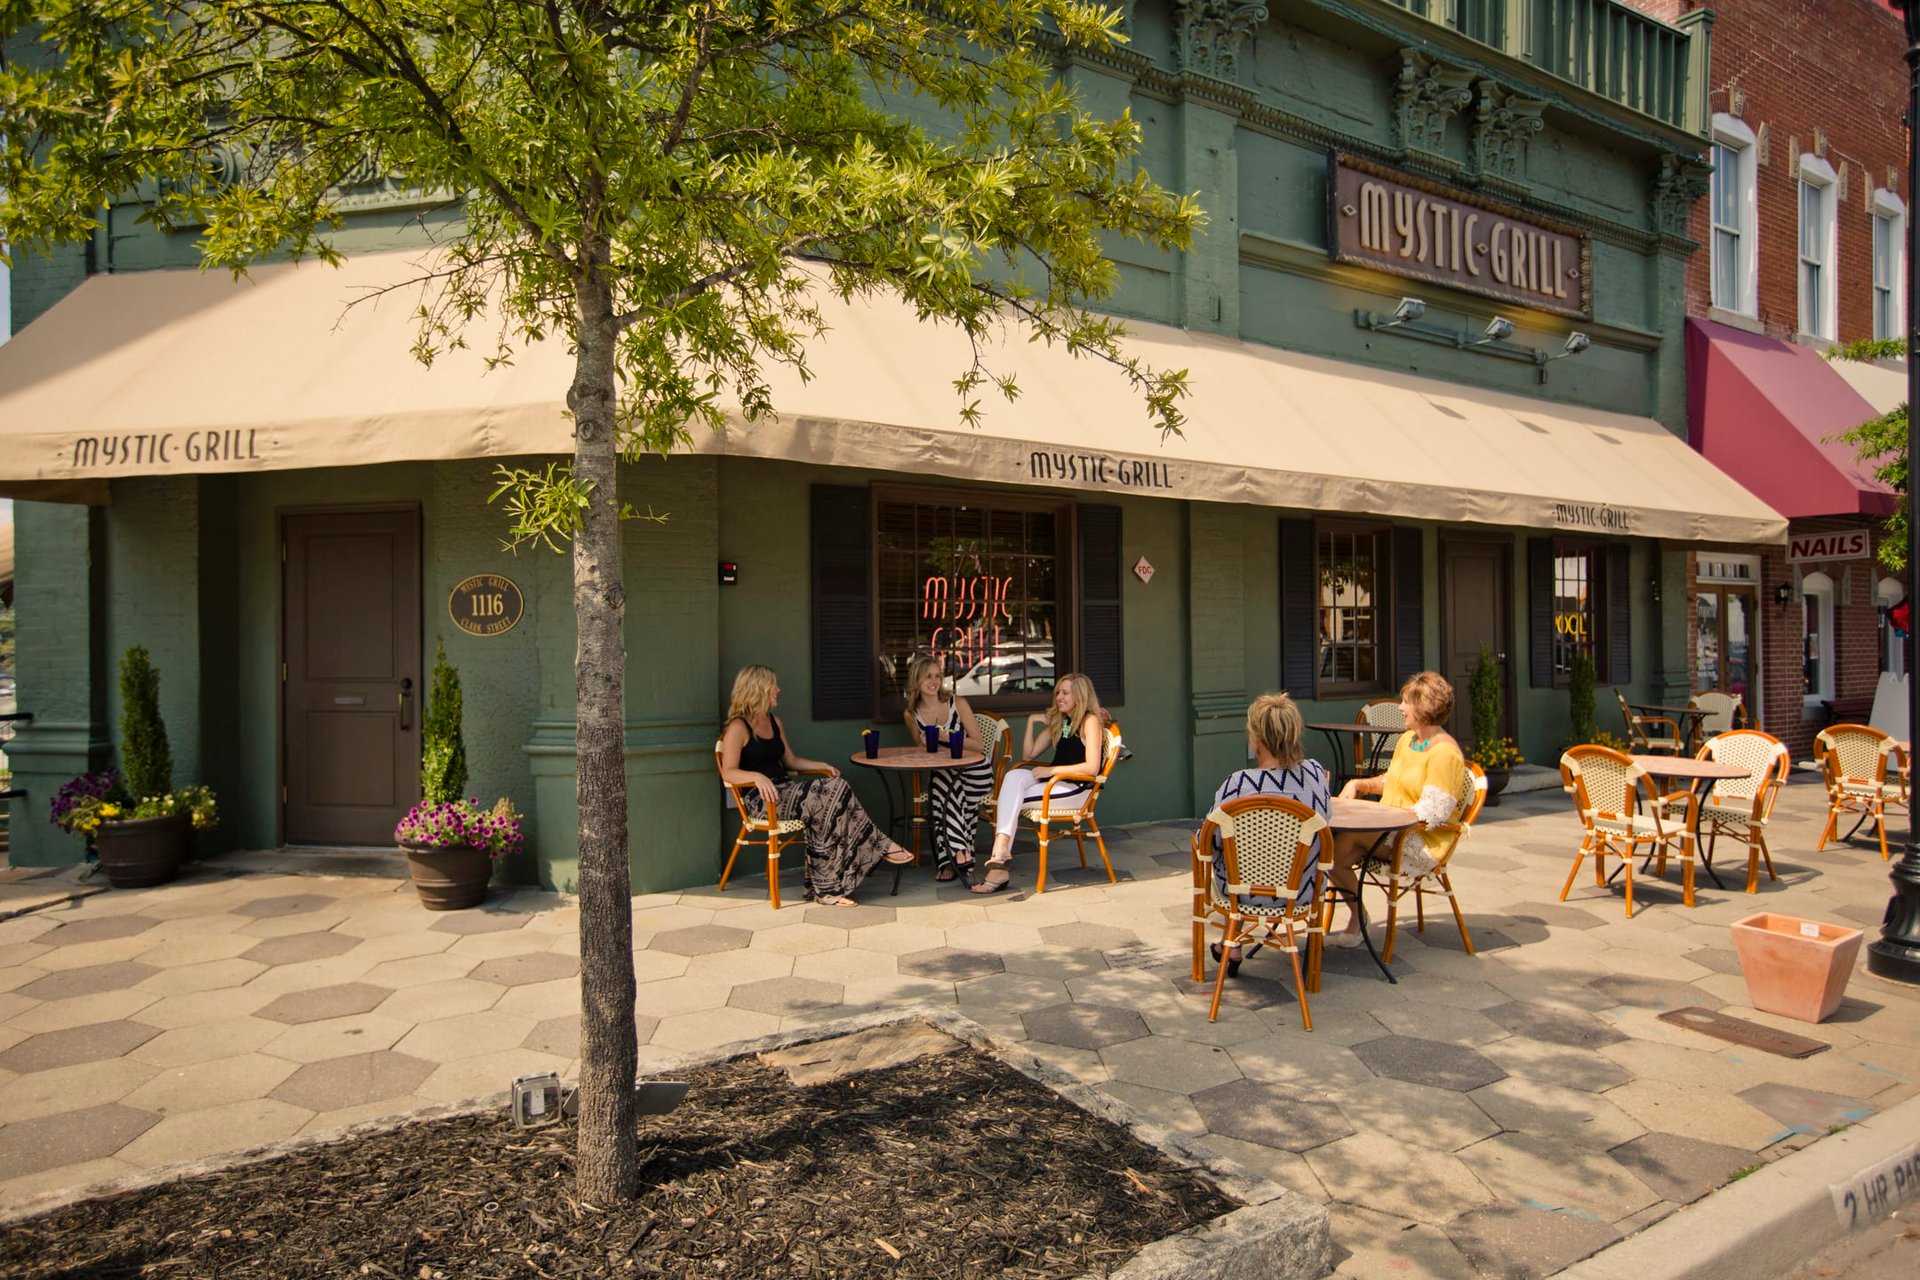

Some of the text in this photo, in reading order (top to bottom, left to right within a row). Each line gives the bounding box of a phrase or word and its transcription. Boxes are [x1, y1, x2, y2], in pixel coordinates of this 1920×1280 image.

[1360, 181, 1568, 298] MYSTIC GRILL
[72, 428, 261, 467] MYSTIC GRILL
[1030, 452, 1173, 488] MYSTIC GRILL
[1556, 504, 1630, 529] MYSTIC GRILL
[1790, 535, 1864, 558] NAILS
[1137, 566, 1152, 575] FDC
[460, 577, 510, 594] MYSTIC GRILL
[471, 593, 504, 617] 1116
[923, 576, 1013, 620] MYSTIC
[460, 616, 512, 633] CLARK STREET
[1555, 614, 1587, 635] OOL
[1862, 1173, 1889, 1220] HR
